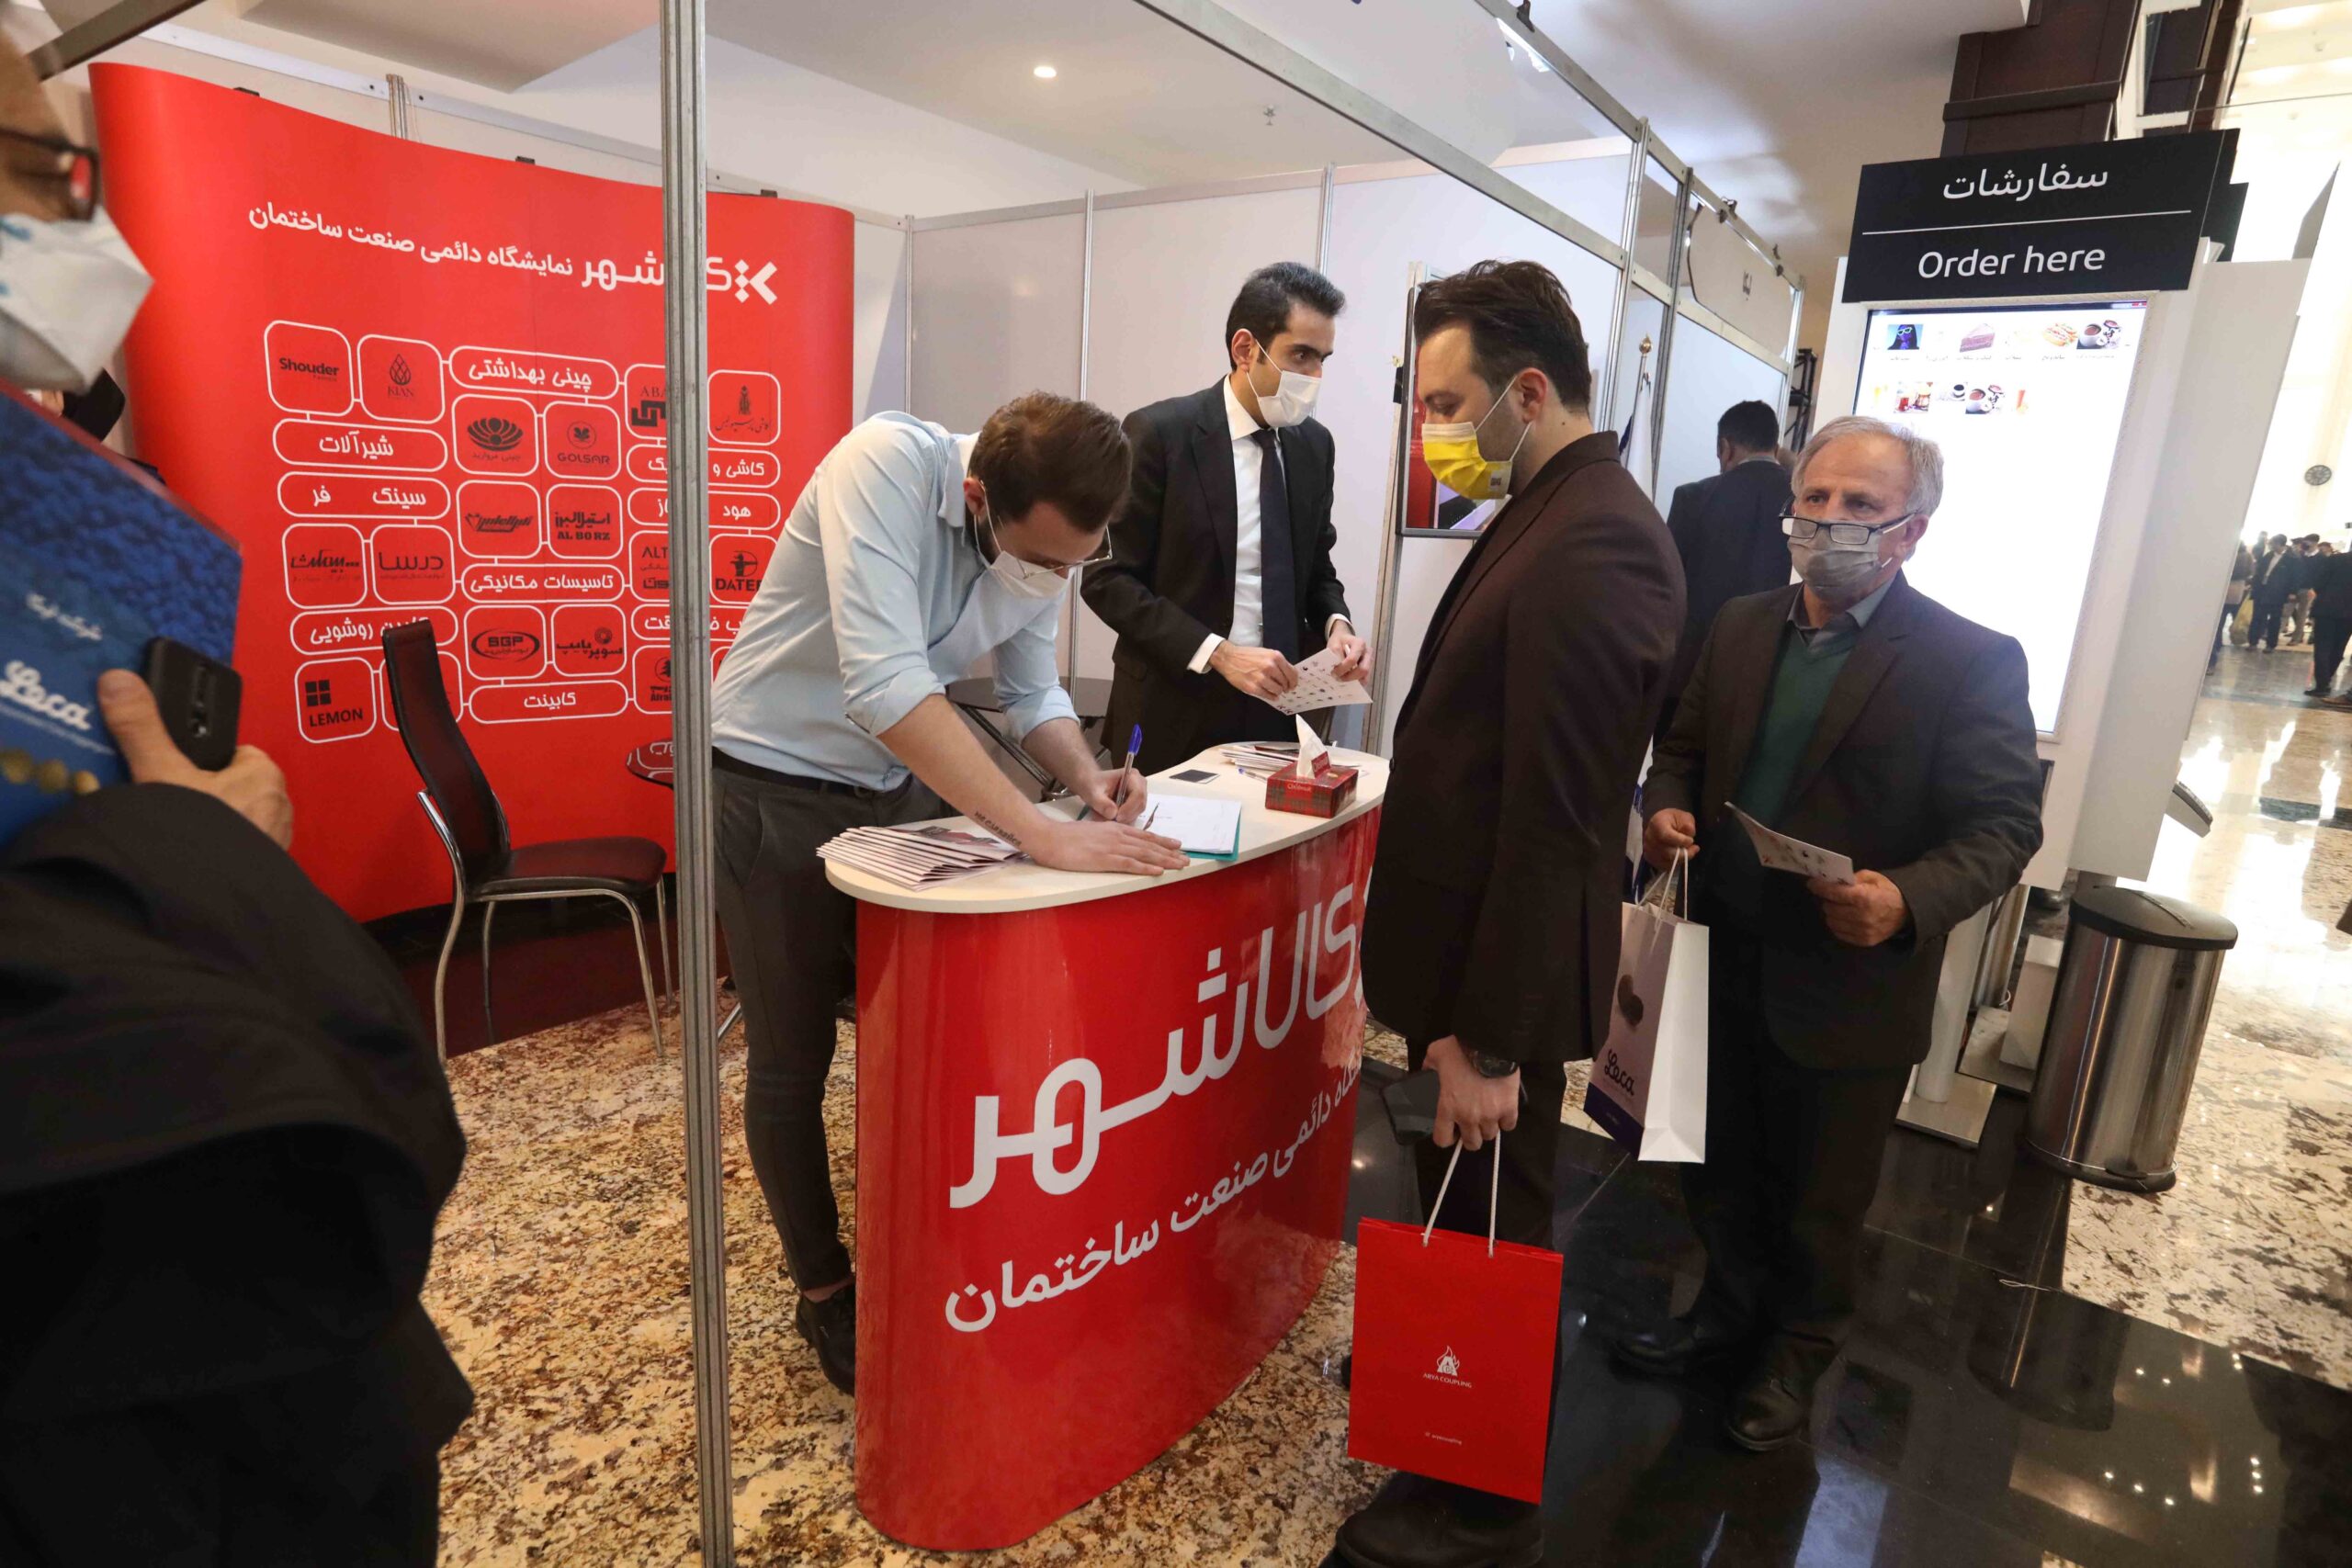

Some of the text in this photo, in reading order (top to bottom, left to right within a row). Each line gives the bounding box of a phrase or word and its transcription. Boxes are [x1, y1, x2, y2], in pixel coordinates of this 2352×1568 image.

[1943, 163, 2108, 202] سفارشات
[248, 201, 343, 238] ساختمان
[347, 227, 415, 252] صنعت
[420, 241, 482, 264] دائمی
[487, 245, 573, 276] نمایشگاه
[1918, 245, 2106, 278] Order here
[279, 357, 339, 376] Shouder
[469, 356, 593, 391] چینی بهداشتی
[557, 452, 610, 465] GOLSAR
[712, 458, 764, 479] کاشی و
[312, 484, 332, 507] فر
[372, 488, 426, 510] سینک
[723, 505, 752, 520] هود
[469, 573, 614, 594] تاسیسات مکانیکی
[310, 617, 373, 645] روشویی
[524, 692, 576, 710] کابینت
[308, 707, 365, 728] LEMON
[949, 883, 1358, 1209] کالاشهر
[1604, 1048, 1635, 1097] Leca
[1272, 1089, 1331, 1179] دائمی
[1169, 1150, 1269, 1233] صنعت
[944, 1219, 1159, 1333] ساختمان
[1422, 1371, 1473, 1389] ARYA COUPLING
